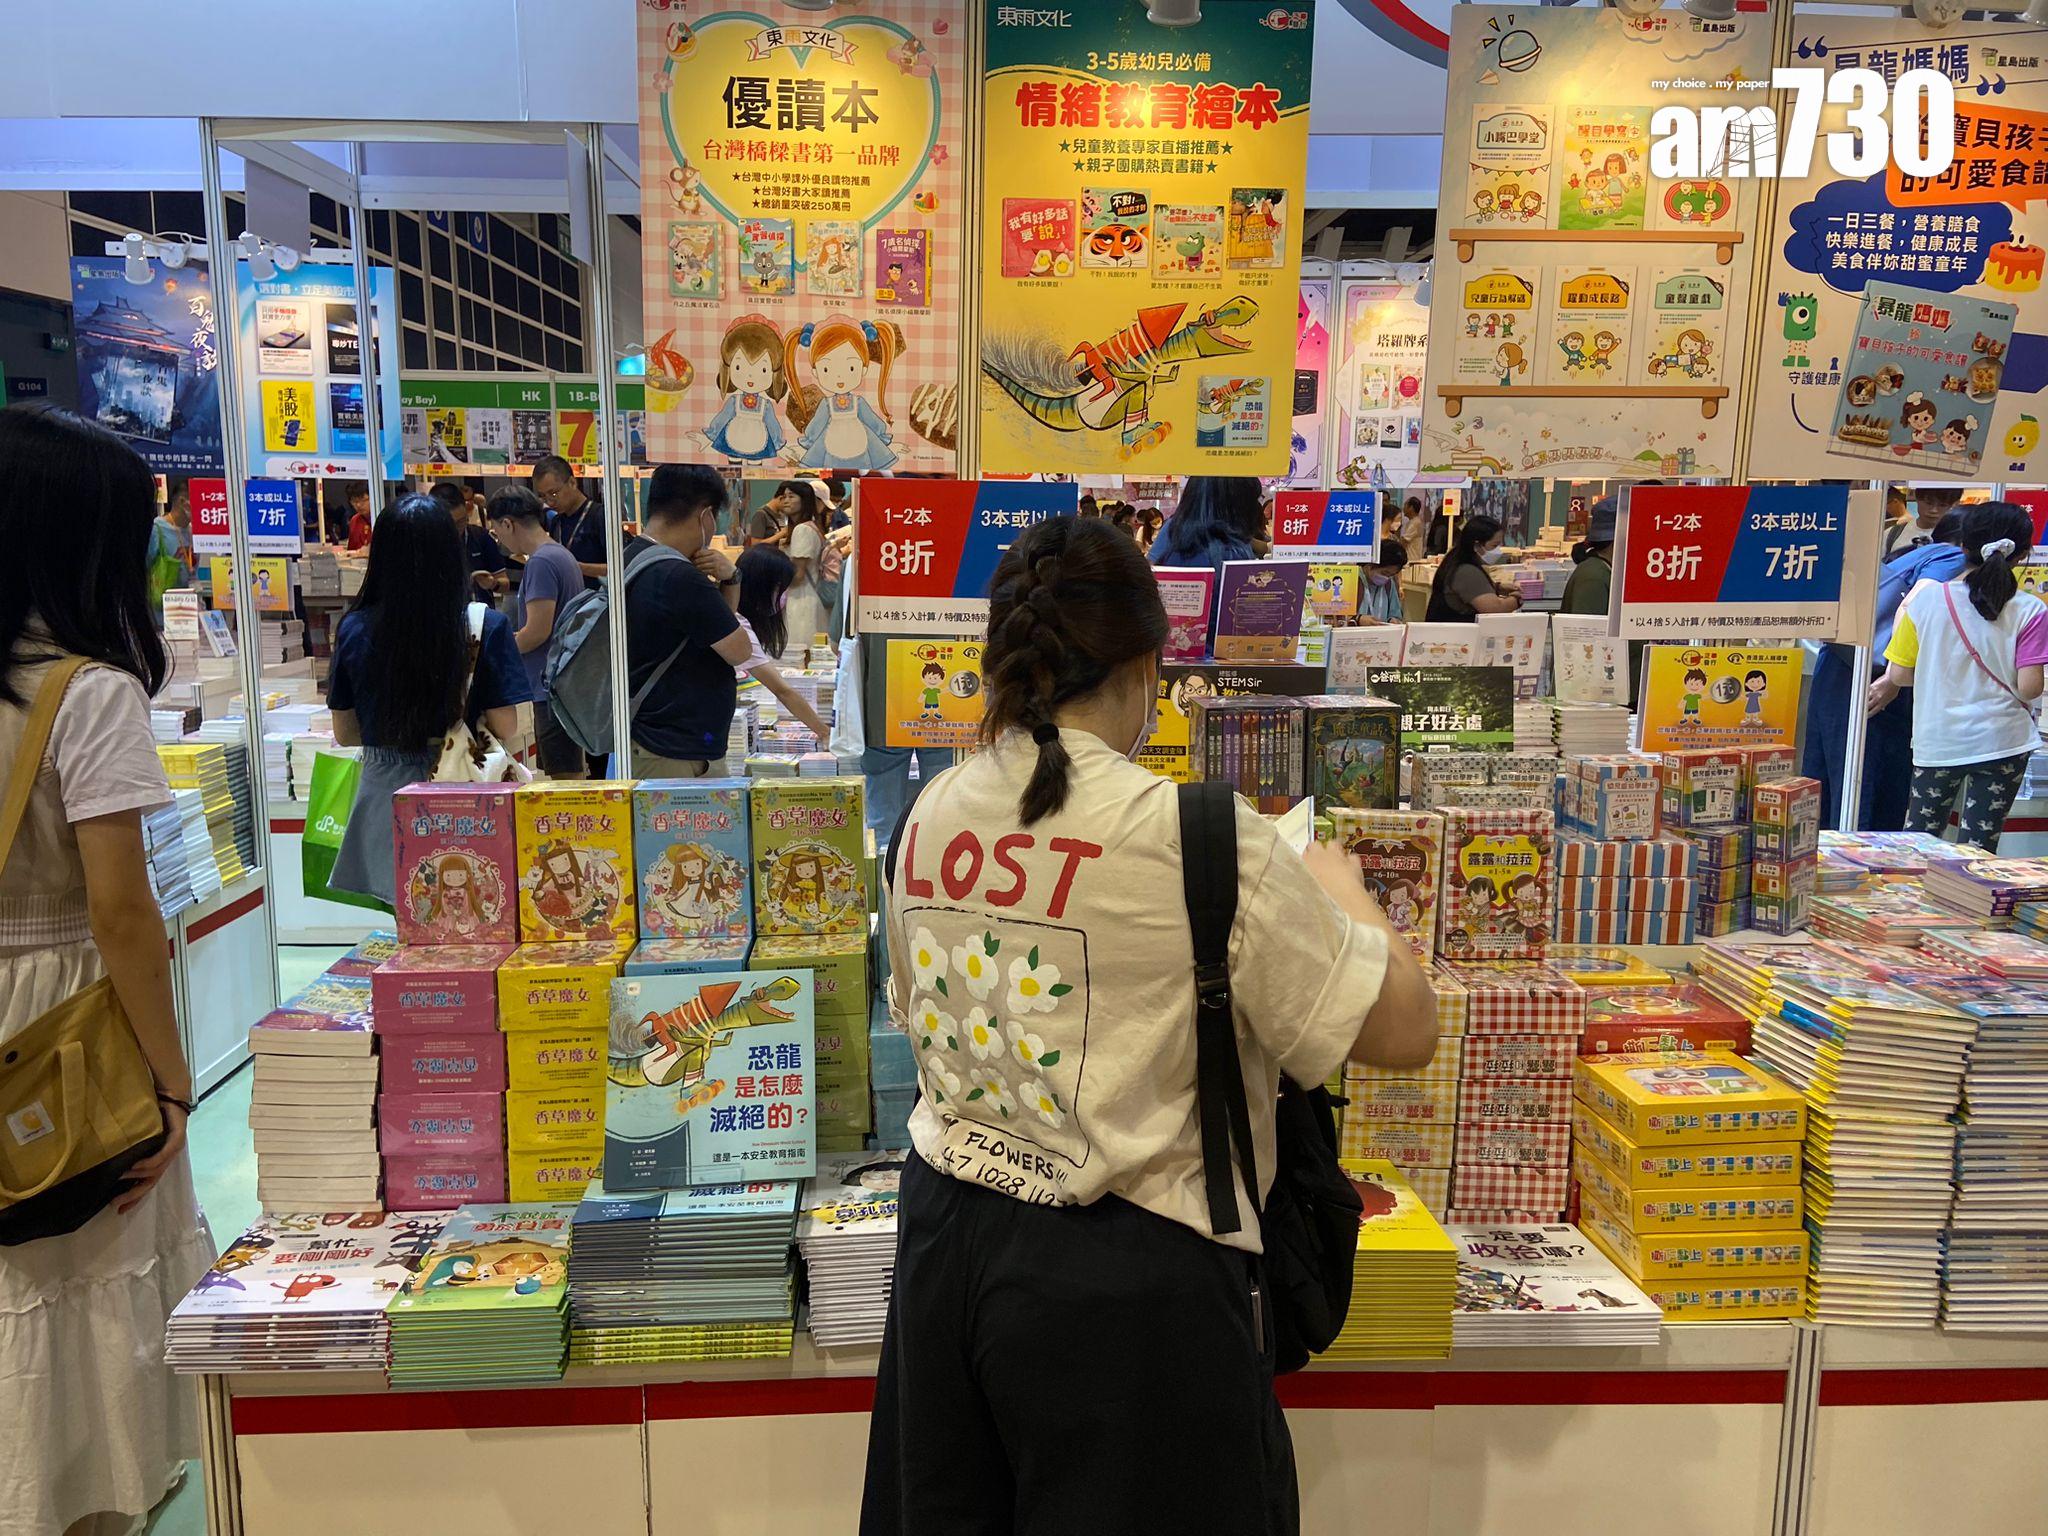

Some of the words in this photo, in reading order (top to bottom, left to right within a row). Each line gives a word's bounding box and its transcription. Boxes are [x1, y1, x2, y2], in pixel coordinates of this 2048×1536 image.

[997, 7, 1072, 28] 東雨文化
[767, 30, 837, 49] 東雨文化
[1086, 52, 1212, 71] 3-5歲幼兒必備
[1997, 56, 2039, 68] 星島出版
[722, 75, 879, 133] 優讀本
[1015, 82, 1281, 130] 情緒教育繪本
[703, 139, 900, 167] 台灣橋樑書第一品牌
[1072, 138, 1220, 155] 兒童教養專家直播推薦
[1086, 158, 1204, 174] 親子團購熱賣書籍
[1112, 196, 1136, 208] 不對!
[1008, 207, 1068, 231] 我有好多話
[1827, 212, 1981, 232] 一日三餐,營養膳食
[1826, 232, 1978, 254] 快樂進餐,健康成長
[1831, 252, 1968, 273] 美食伴妳甜蜜童年
[1877, 295, 1951, 331] 暴龍媽媽
[1788, 372, 1841, 386] 守護健康
[284, 387, 299, 417] 美股
[521, 391, 541, 401] HK
[560, 411, 595, 458] 7
[249, 493, 293, 503] 3本或以上
[200, 508, 228, 525] 8折
[258, 508, 286, 526] 7折
[884, 507, 933, 527] 1-2本
[1286, 504, 1309, 513] 1-2本
[1329, 504, 1371, 514] 3本或以上
[1283, 519, 1309, 536] 8折
[1337, 519, 1362, 536] 7折
[1654, 513, 1702, 532] 1-2本
[1750, 512, 1838, 531] 3本或以上
[879, 540, 935, 576] 8折
[1646, 545, 1702, 581] 8折
[1765, 544, 1819, 581] 7折
[1401, 714, 1482, 731] 親子好去處
[411, 813, 496, 837] 香草魔女
[534, 811, 617, 836] 香草魔女
[652, 808, 732, 833] 香草魔女
[767, 806, 849, 829] 香草魔女
[904, 821, 1103, 919] LOST
[399, 991, 466, 1009] 香草魔女
[527, 988, 591, 1005] 香草魔女
[536, 1048, 600, 1066] 香草魔女
[747, 1043, 802, 1071] 恐龍
[734, 1074, 804, 1099] 是怎麼
[535, 1109, 599, 1126] 香草魔女
[709, 1102, 809, 1133] 滅絕的?
[712, 1149, 806, 1163] 這是一本安全教育指南
[976, 1163, 1027, 1196] 1028
[1461, 1230, 1552, 1244] 一定要
[272, 1248, 374, 1264] 要剛剛好
[1468, 1243, 1586, 1260] 收拾嗎?
